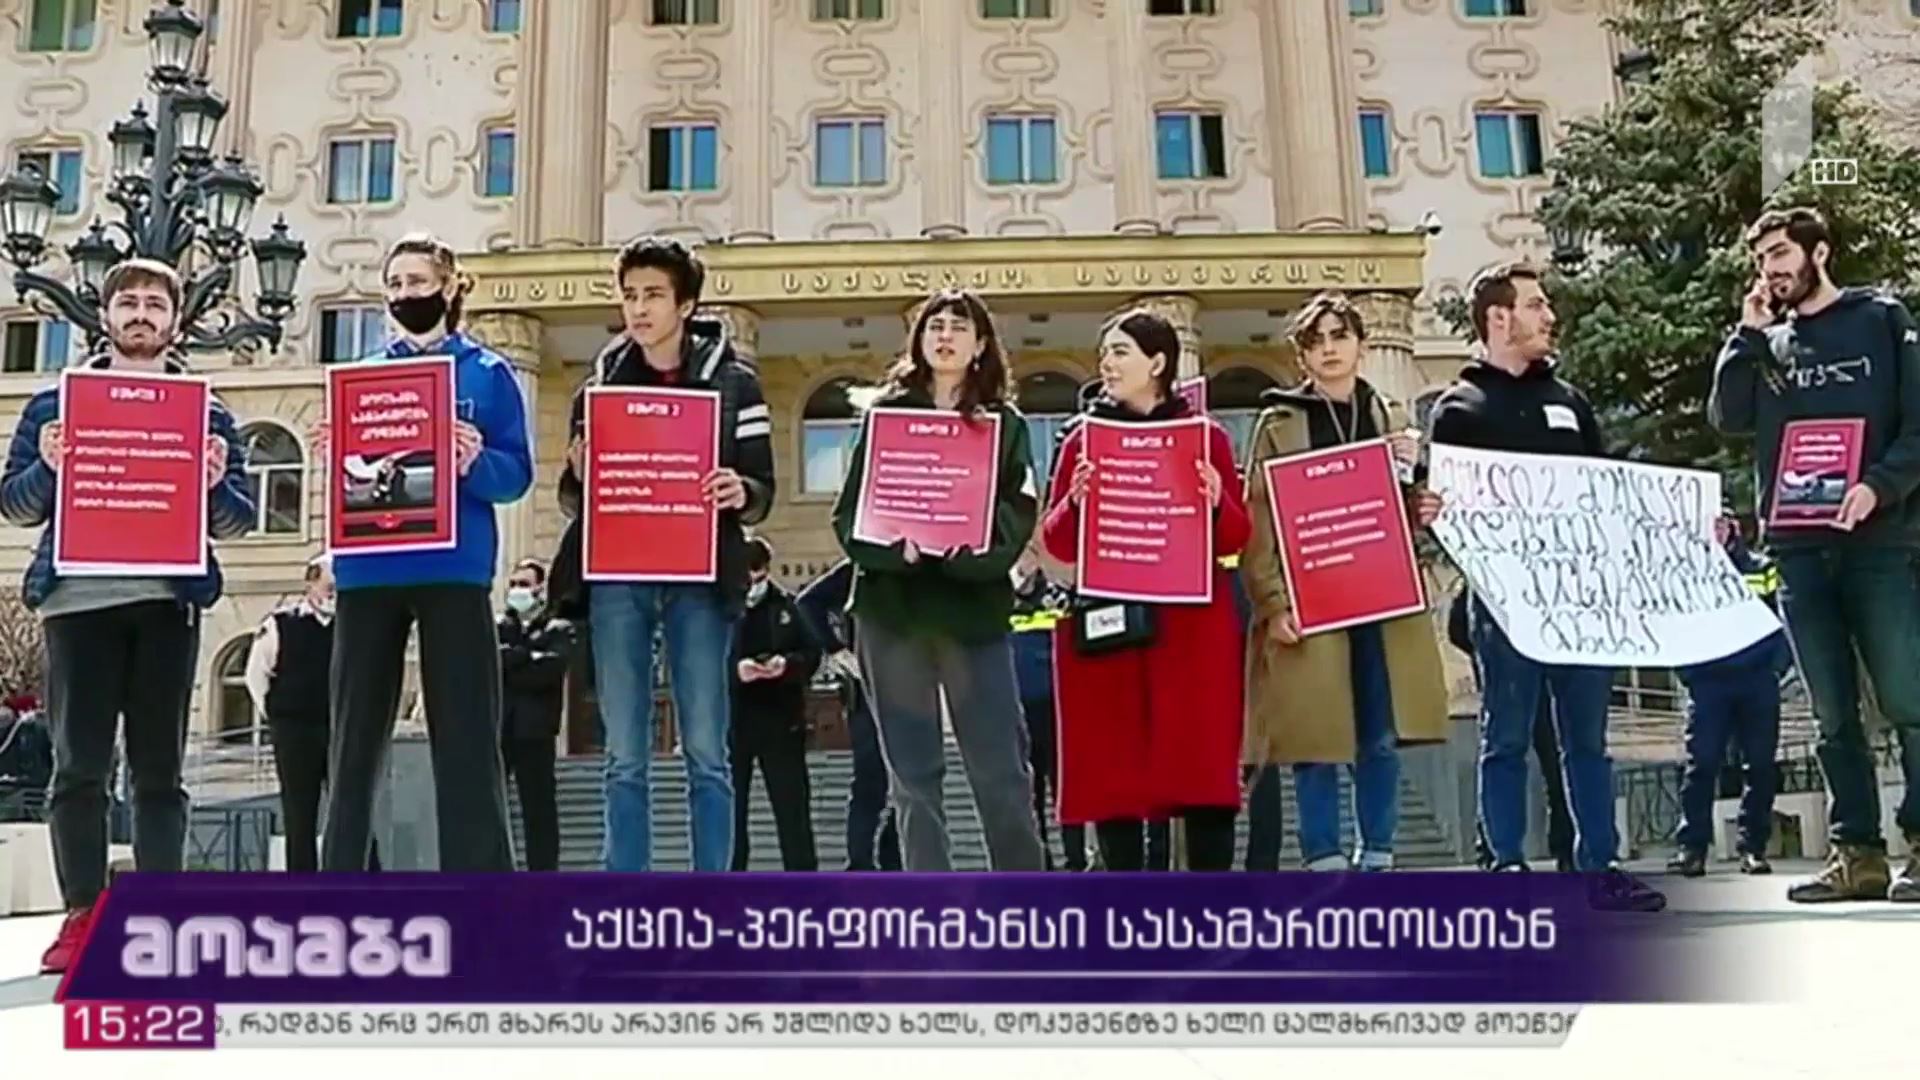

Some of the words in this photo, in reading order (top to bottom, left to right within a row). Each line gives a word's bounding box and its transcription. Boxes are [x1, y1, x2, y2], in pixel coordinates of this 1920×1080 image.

[493, 272, 732, 302] თბილს
[781, 266, 1025, 293] საქალაქო
[1075, 261, 1384, 286] სასამართლო
